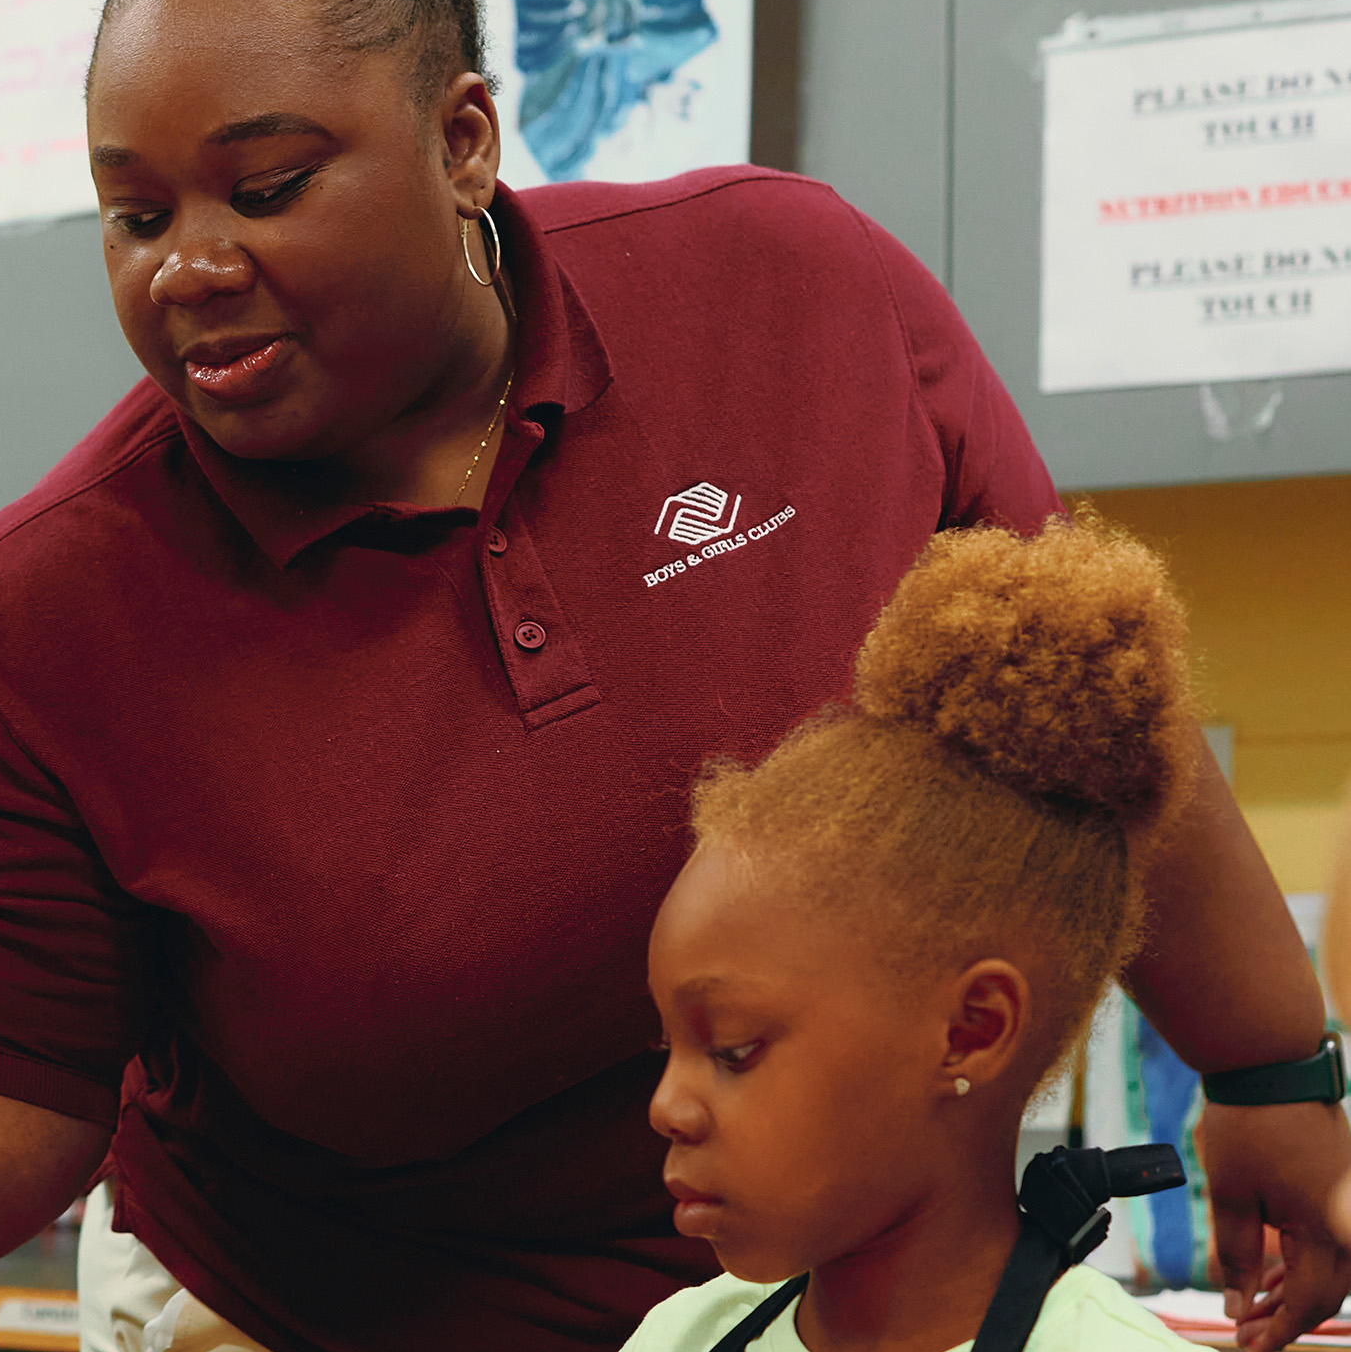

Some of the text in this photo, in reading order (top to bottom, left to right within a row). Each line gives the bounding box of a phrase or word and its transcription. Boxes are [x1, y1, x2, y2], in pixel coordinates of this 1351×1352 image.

[1133, 79, 1250, 112] PLEASE
[1266, 73, 1314, 97] DO
[1202, 112, 1315, 146] TOUCH
[1130, 255, 1247, 287] PLEASE
[1262, 246, 1313, 275] DO
[1200, 287, 1313, 322] TOUCH
[643, 505, 797, 588] BOYS & GIRLS CLUBS
